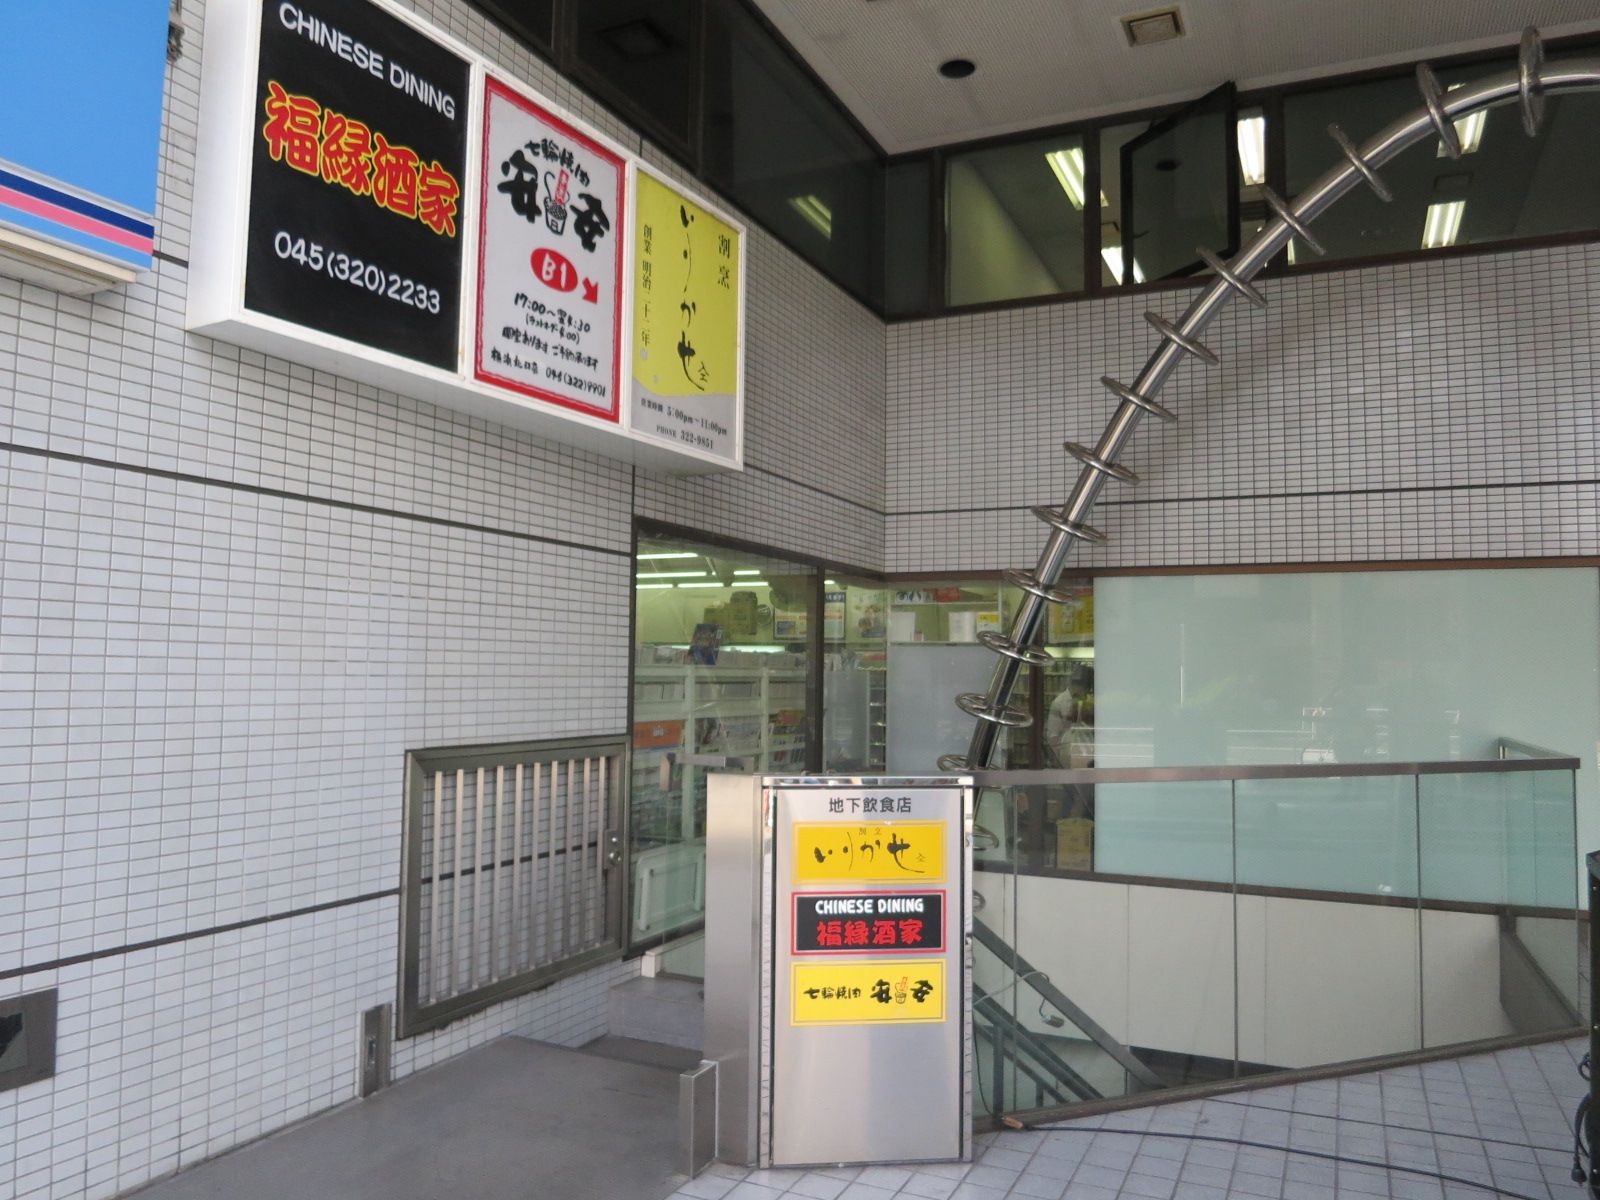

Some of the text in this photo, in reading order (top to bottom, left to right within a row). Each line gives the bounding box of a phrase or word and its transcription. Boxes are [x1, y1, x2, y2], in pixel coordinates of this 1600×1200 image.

[279, 3, 456, 121] CHINESE DINING
[263, 80, 459, 238] 福縁酒家
[524, 138, 590, 188] 七輪焼肉
[274, 231, 440, 314] 045(320)2233
[541, 253, 568, 289] B1
[656, 424, 677, 439] PHONE
[828, 797, 913, 814] 地下飲食店
[815, 898, 924, 915] CHINESE DINING
[816, 919, 924, 947] 福縁酒家
[803, 986, 861, 1000] 七輪焼肉
